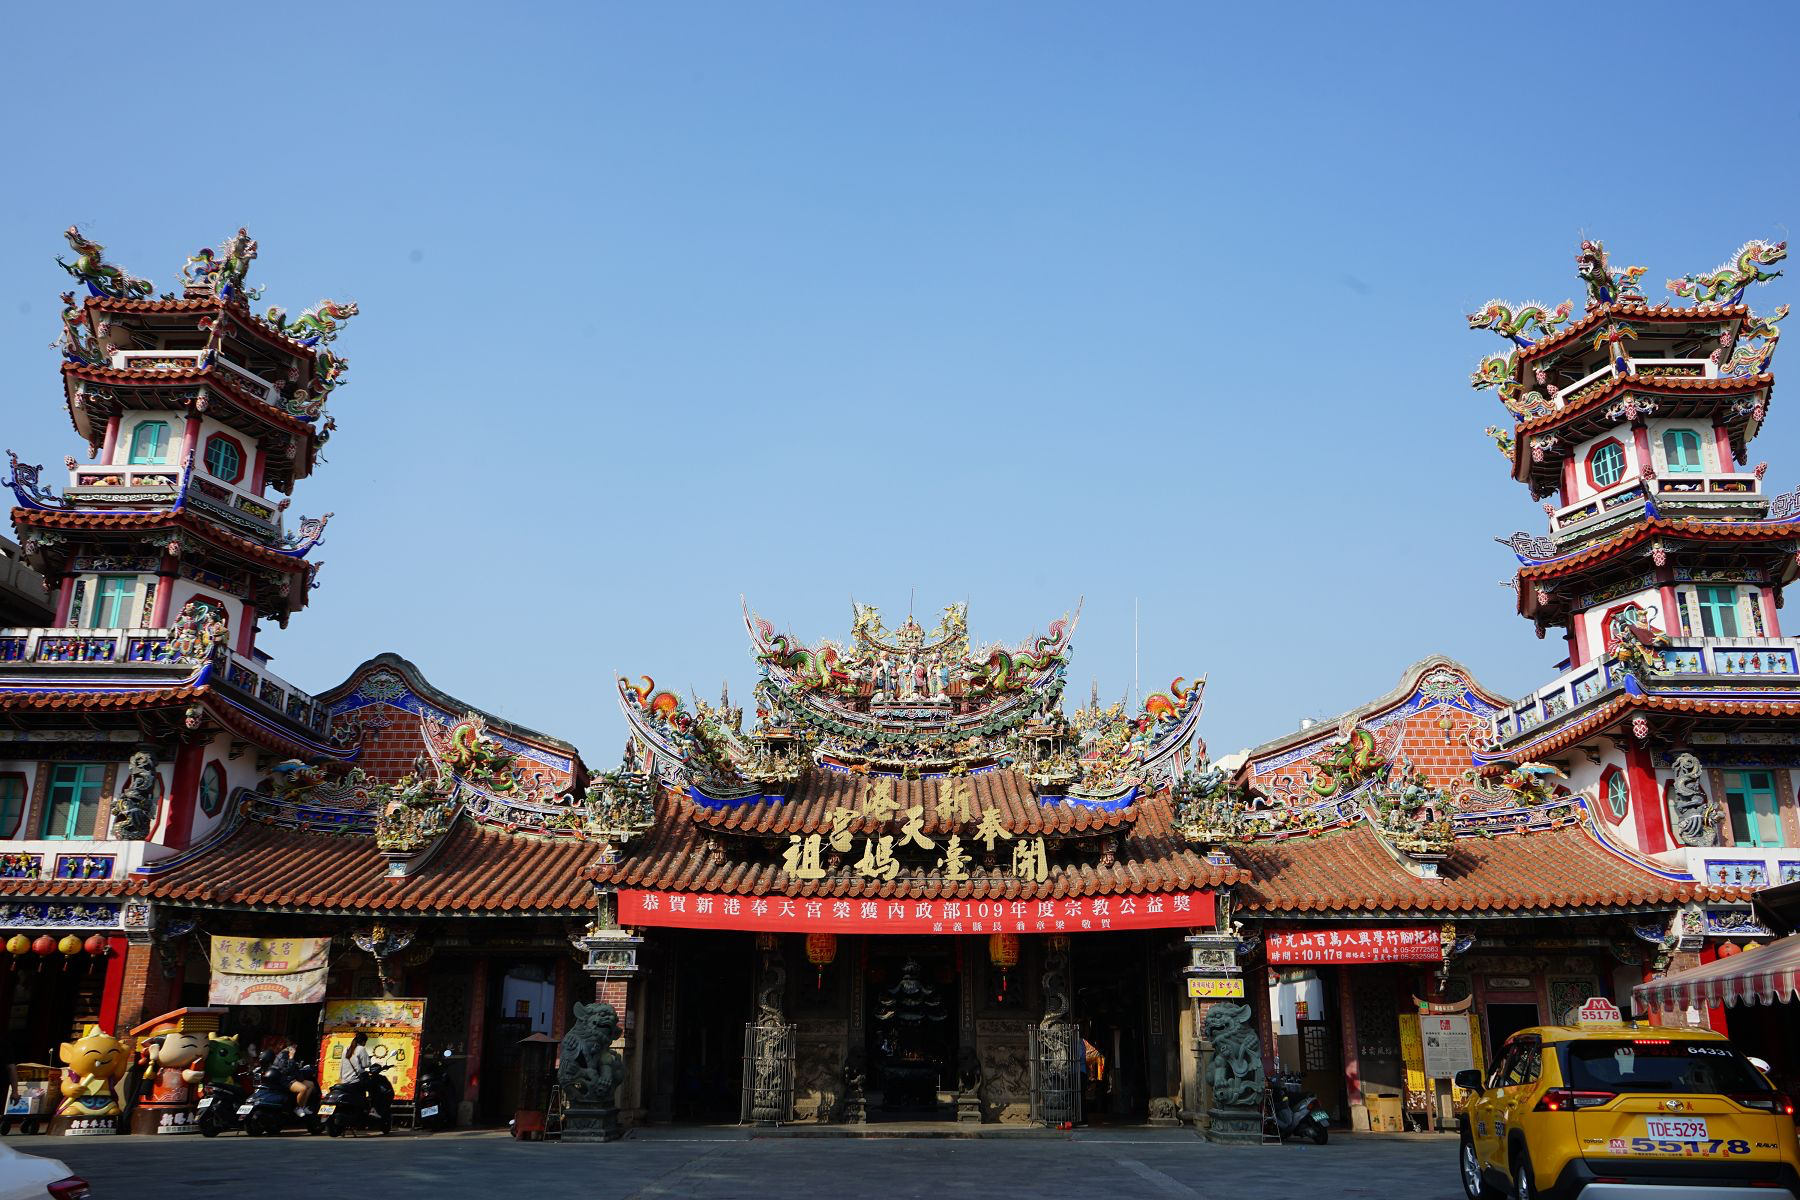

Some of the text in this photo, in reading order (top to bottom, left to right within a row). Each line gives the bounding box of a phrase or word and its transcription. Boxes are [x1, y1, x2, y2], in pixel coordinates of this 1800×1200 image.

[218, 939, 293, 955] 新港奉天宮
[1582, 1011, 1620, 1021] 55178
[1648, 1121, 1707, 1137] TDE-5293
[1631, 1138, 1751, 1154] 55178
